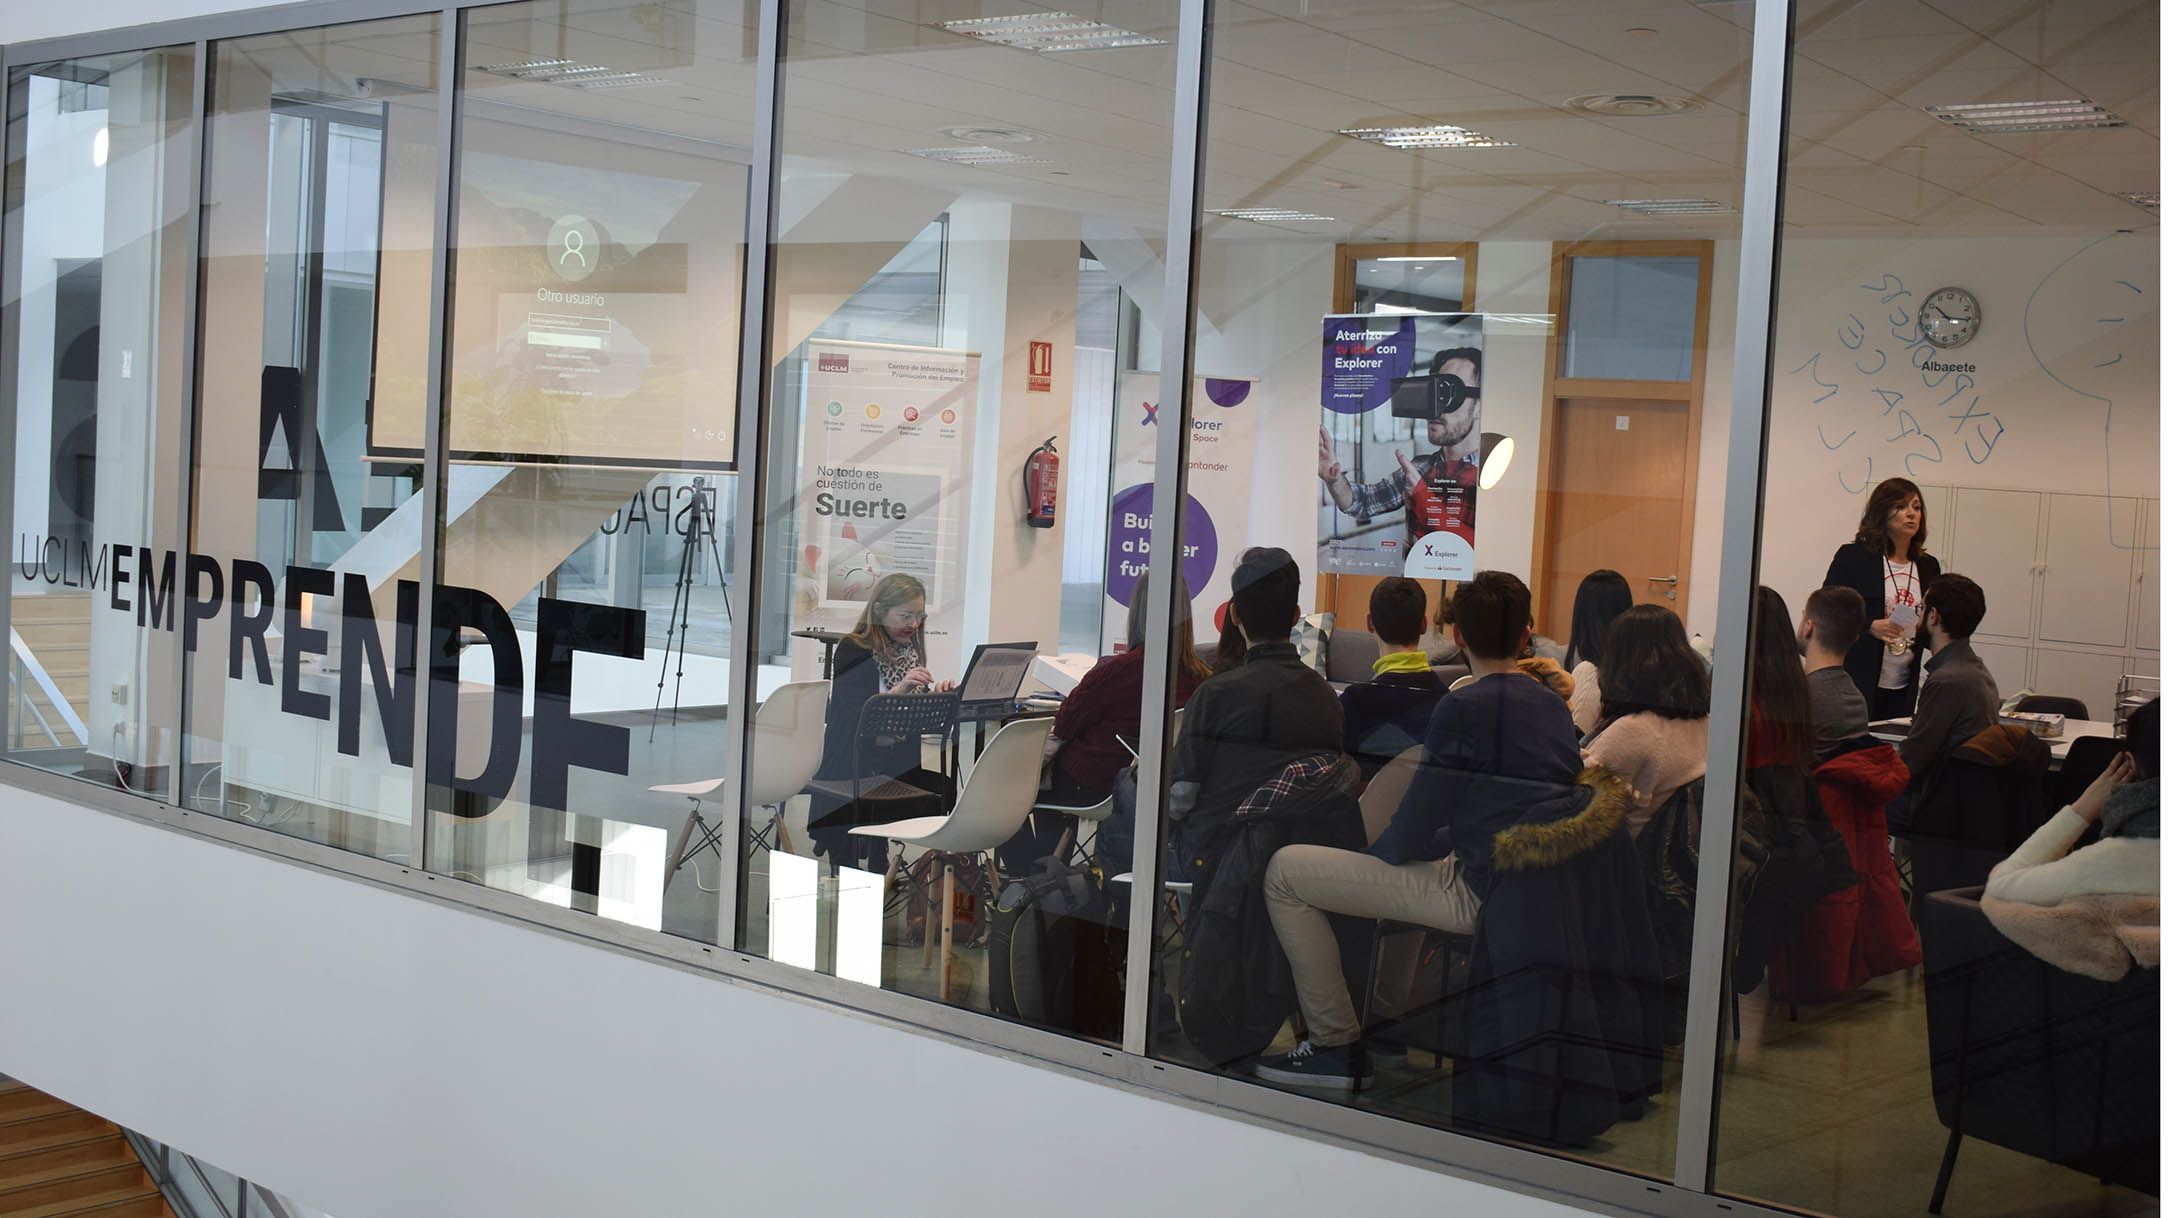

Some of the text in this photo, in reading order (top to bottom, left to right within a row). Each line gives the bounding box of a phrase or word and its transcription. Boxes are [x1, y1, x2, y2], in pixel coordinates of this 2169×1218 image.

[537, 288, 605, 307] Otro usuario
[1335, 329, 1382, 341] Aterriza
[1376, 345, 1397, 355] con
[888, 362, 909, 371] Centro
[910, 363, 919, 371] de
[920, 364, 959, 375] Información
[1334, 357, 1383, 371] Explorer
[1921, 361, 1976, 373] Albacete
[1193, 433, 1218, 443] Space
[1188, 460, 1229, 471] antander
[817, 465, 879, 480] No todo es
[816, 478, 883, 492] cuestión de
[816, 492, 907, 520] Suerte
[1124, 512, 1153, 529] Bui
[1122, 540, 1134, 553] a
[1434, 550, 1458, 559] Explorer
